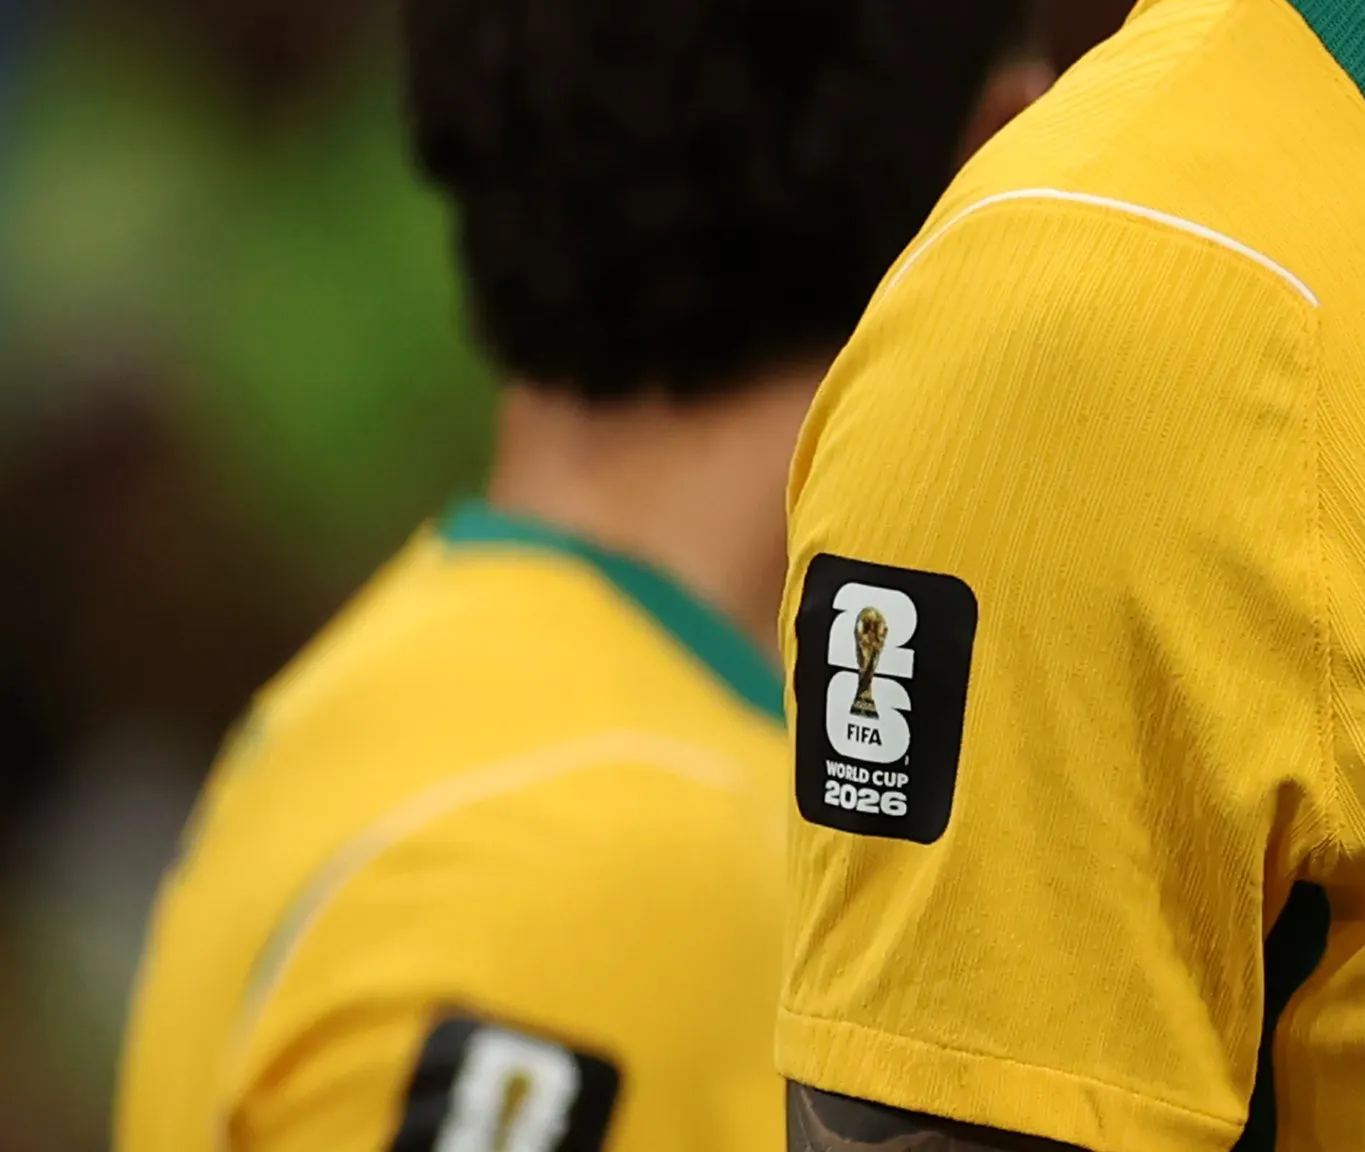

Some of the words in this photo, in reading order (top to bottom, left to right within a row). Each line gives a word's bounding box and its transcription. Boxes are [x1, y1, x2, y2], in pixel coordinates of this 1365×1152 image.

[847, 723, 882, 747] FIFA
[825, 759, 870, 784] WORLD
[871, 769, 909, 789] CUP
[824, 779, 908, 817] 2026
